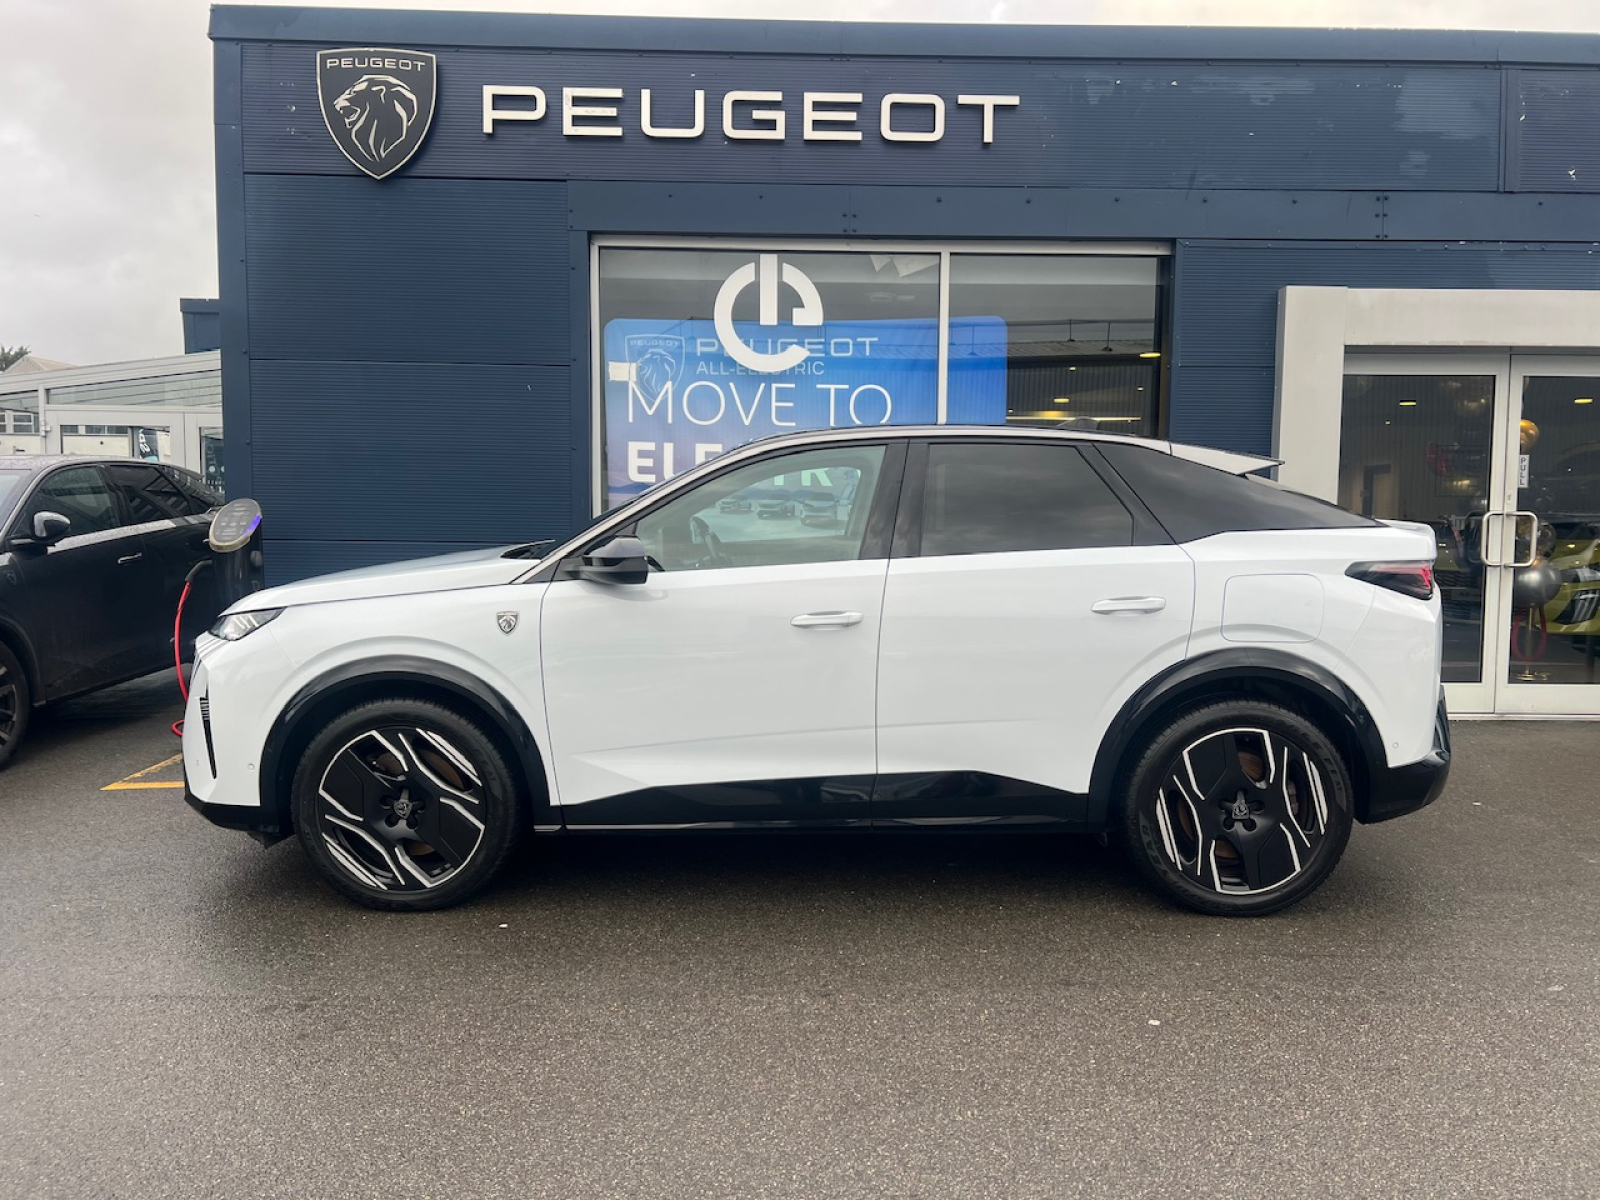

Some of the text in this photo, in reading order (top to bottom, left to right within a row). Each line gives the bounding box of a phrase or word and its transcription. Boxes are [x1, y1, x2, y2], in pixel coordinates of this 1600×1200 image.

[326, 58, 426, 72] PEUGEOT
[482, 84, 1020, 144] PEUGEOT
[628, 380, 893, 427] MOVE TO
[1519, 456, 1527, 486] PULL
